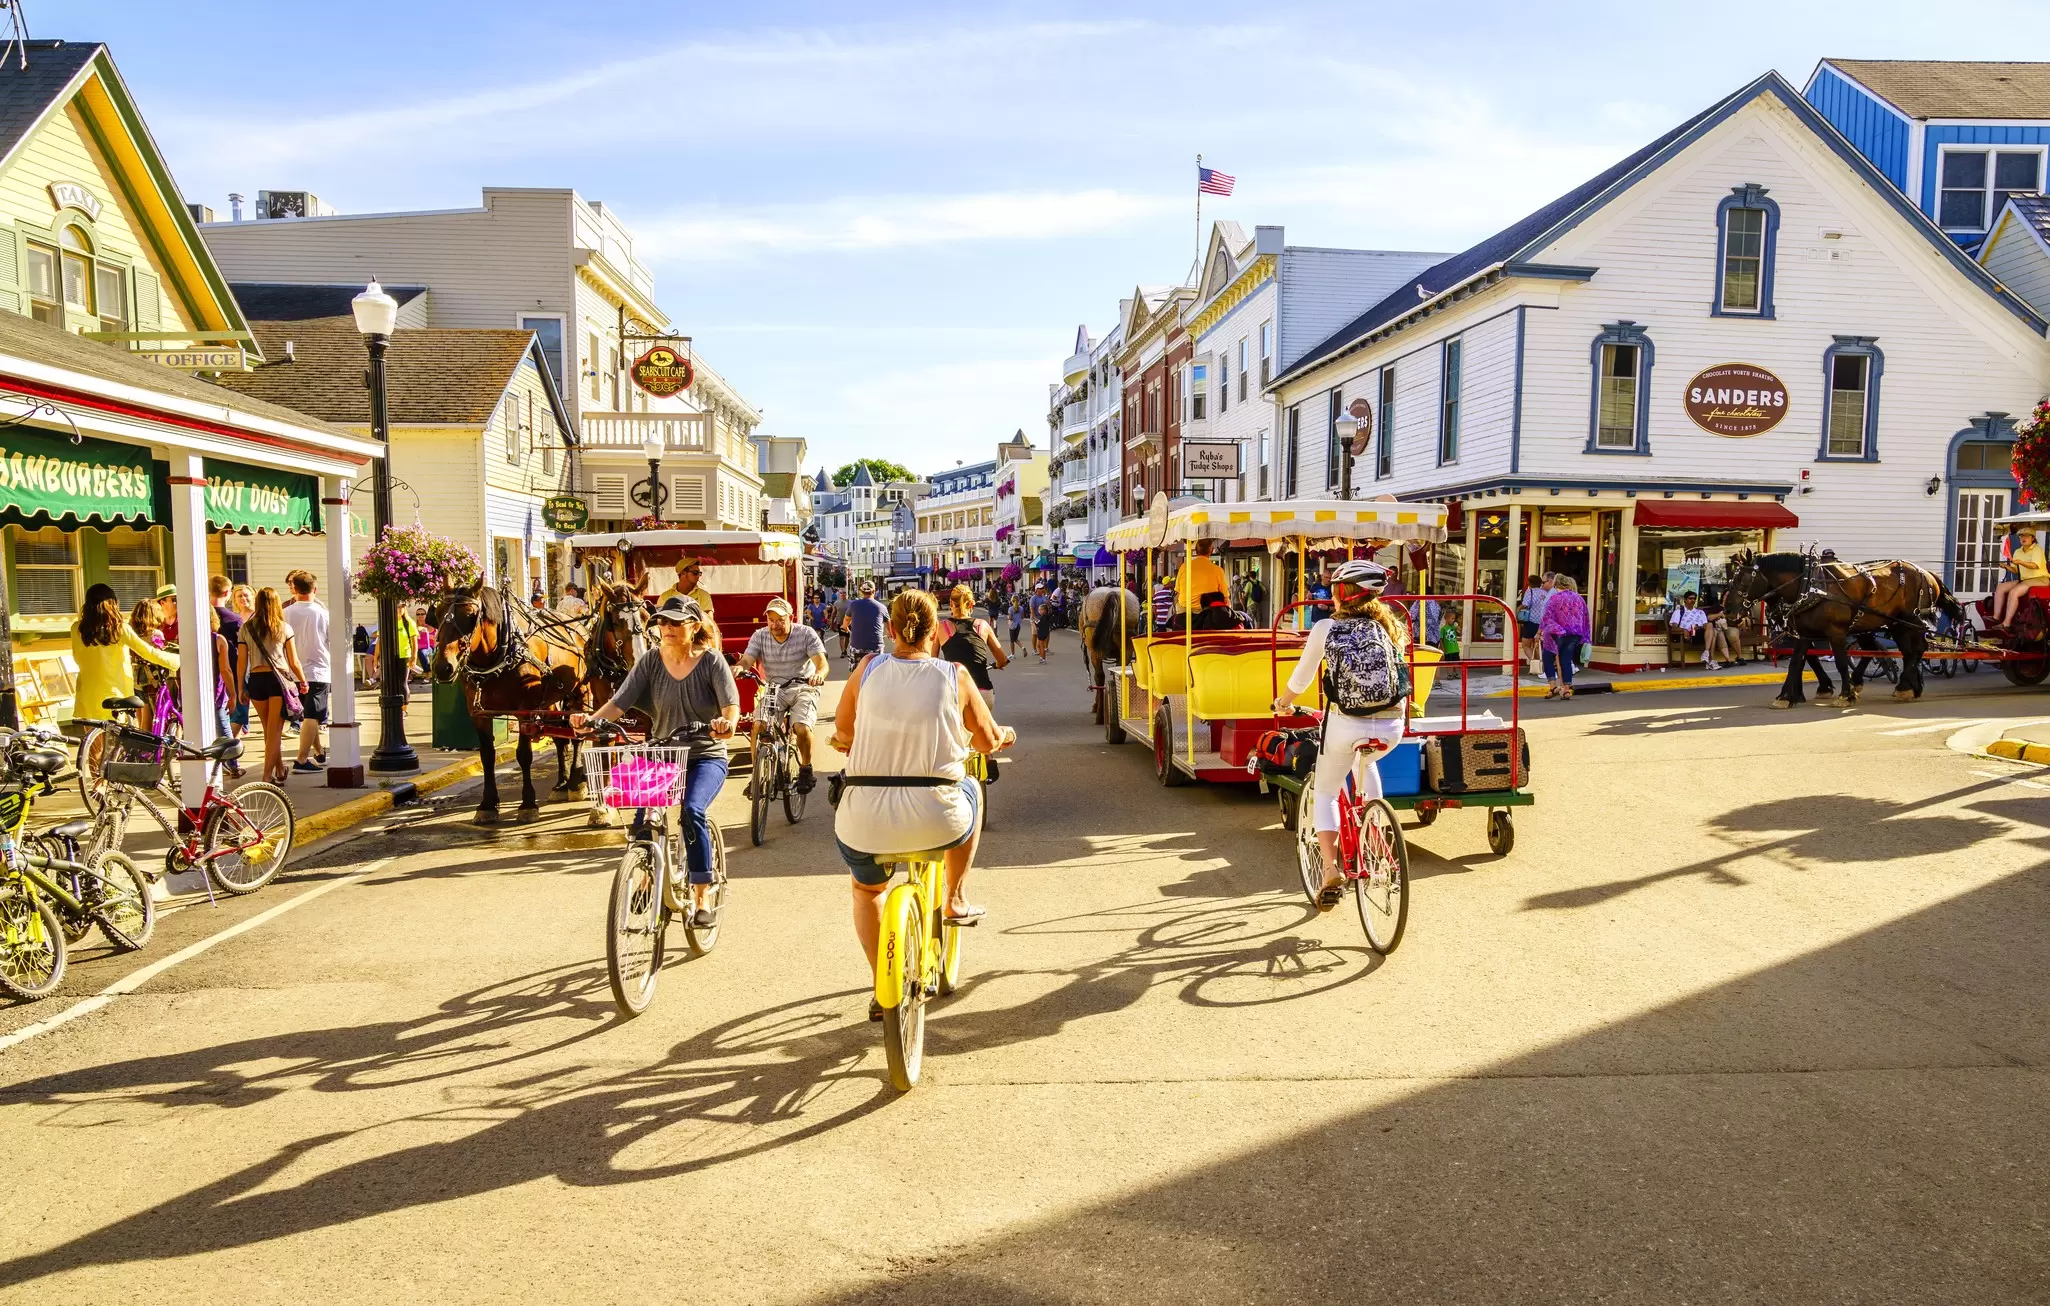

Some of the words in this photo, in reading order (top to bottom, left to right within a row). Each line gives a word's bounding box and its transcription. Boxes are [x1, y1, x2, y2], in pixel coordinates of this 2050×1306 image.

[57, 187, 96, 214] TAXI
[166, 354, 236, 367] OFFICE
[639, 365, 670, 377] SEABISCUIT
[671, 364, 686, 378] CAFÉ
[1702, 370, 1731, 380] CHOCOLATE
[1752, 371, 1774, 382] SHARING
[1691, 387, 1784, 407] SANDERS
[1715, 423, 1737, 431] SINCE
[1200, 450, 1223, 463] Ryba's
[1188, 460, 1210, 472] Fudge
[1211, 461, 1234, 472] Shops
[207, 475, 245, 510] HOT
[250, 483, 289, 515] DOGS
[1681, 557, 1719, 566] SANDE
